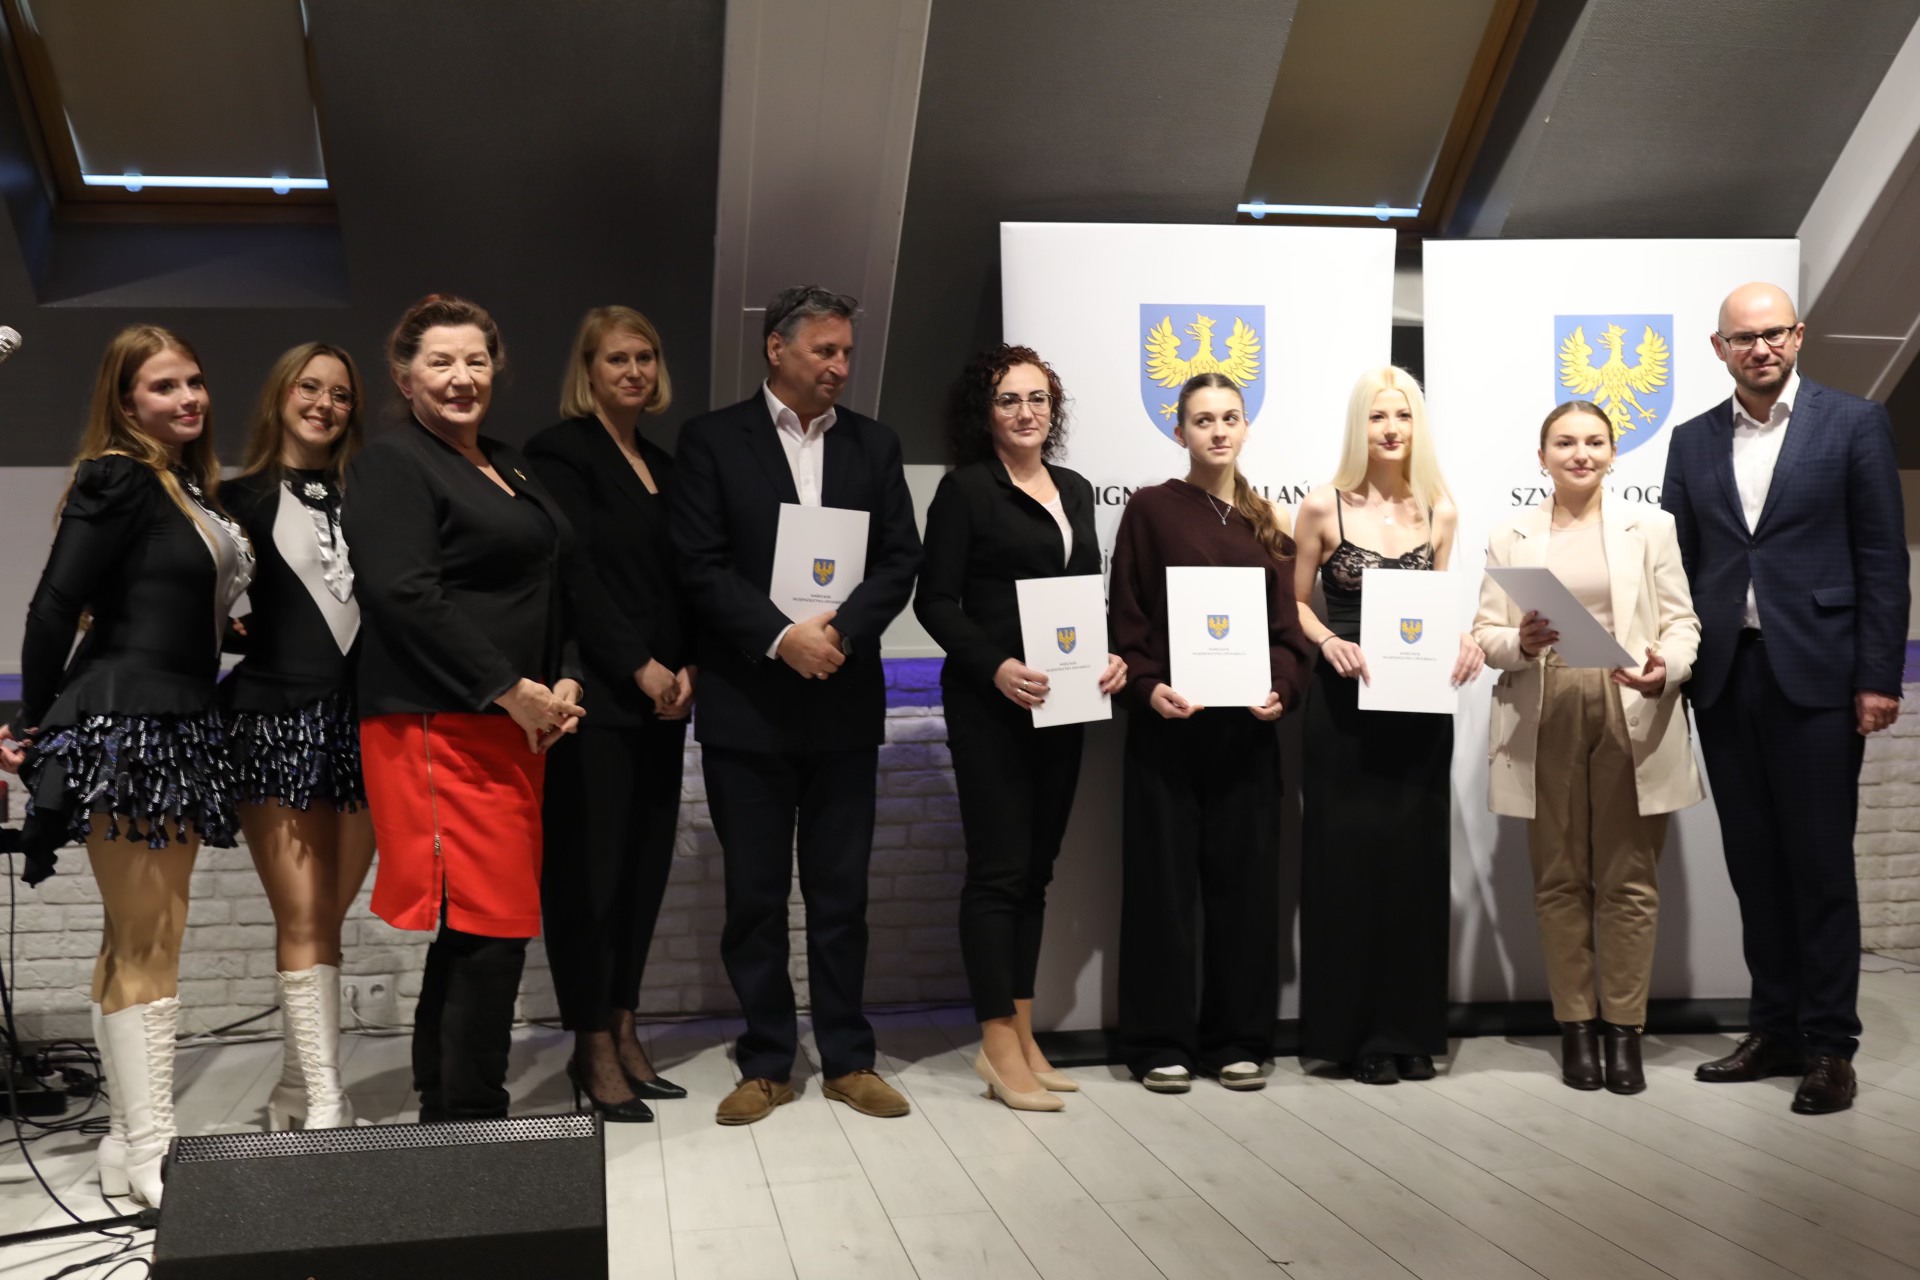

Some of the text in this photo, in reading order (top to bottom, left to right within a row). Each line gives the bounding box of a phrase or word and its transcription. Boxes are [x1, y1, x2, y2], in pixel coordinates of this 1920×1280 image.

[1095, 485, 1139, 506] IGN
[1511, 485, 1662, 506] SZY OG
